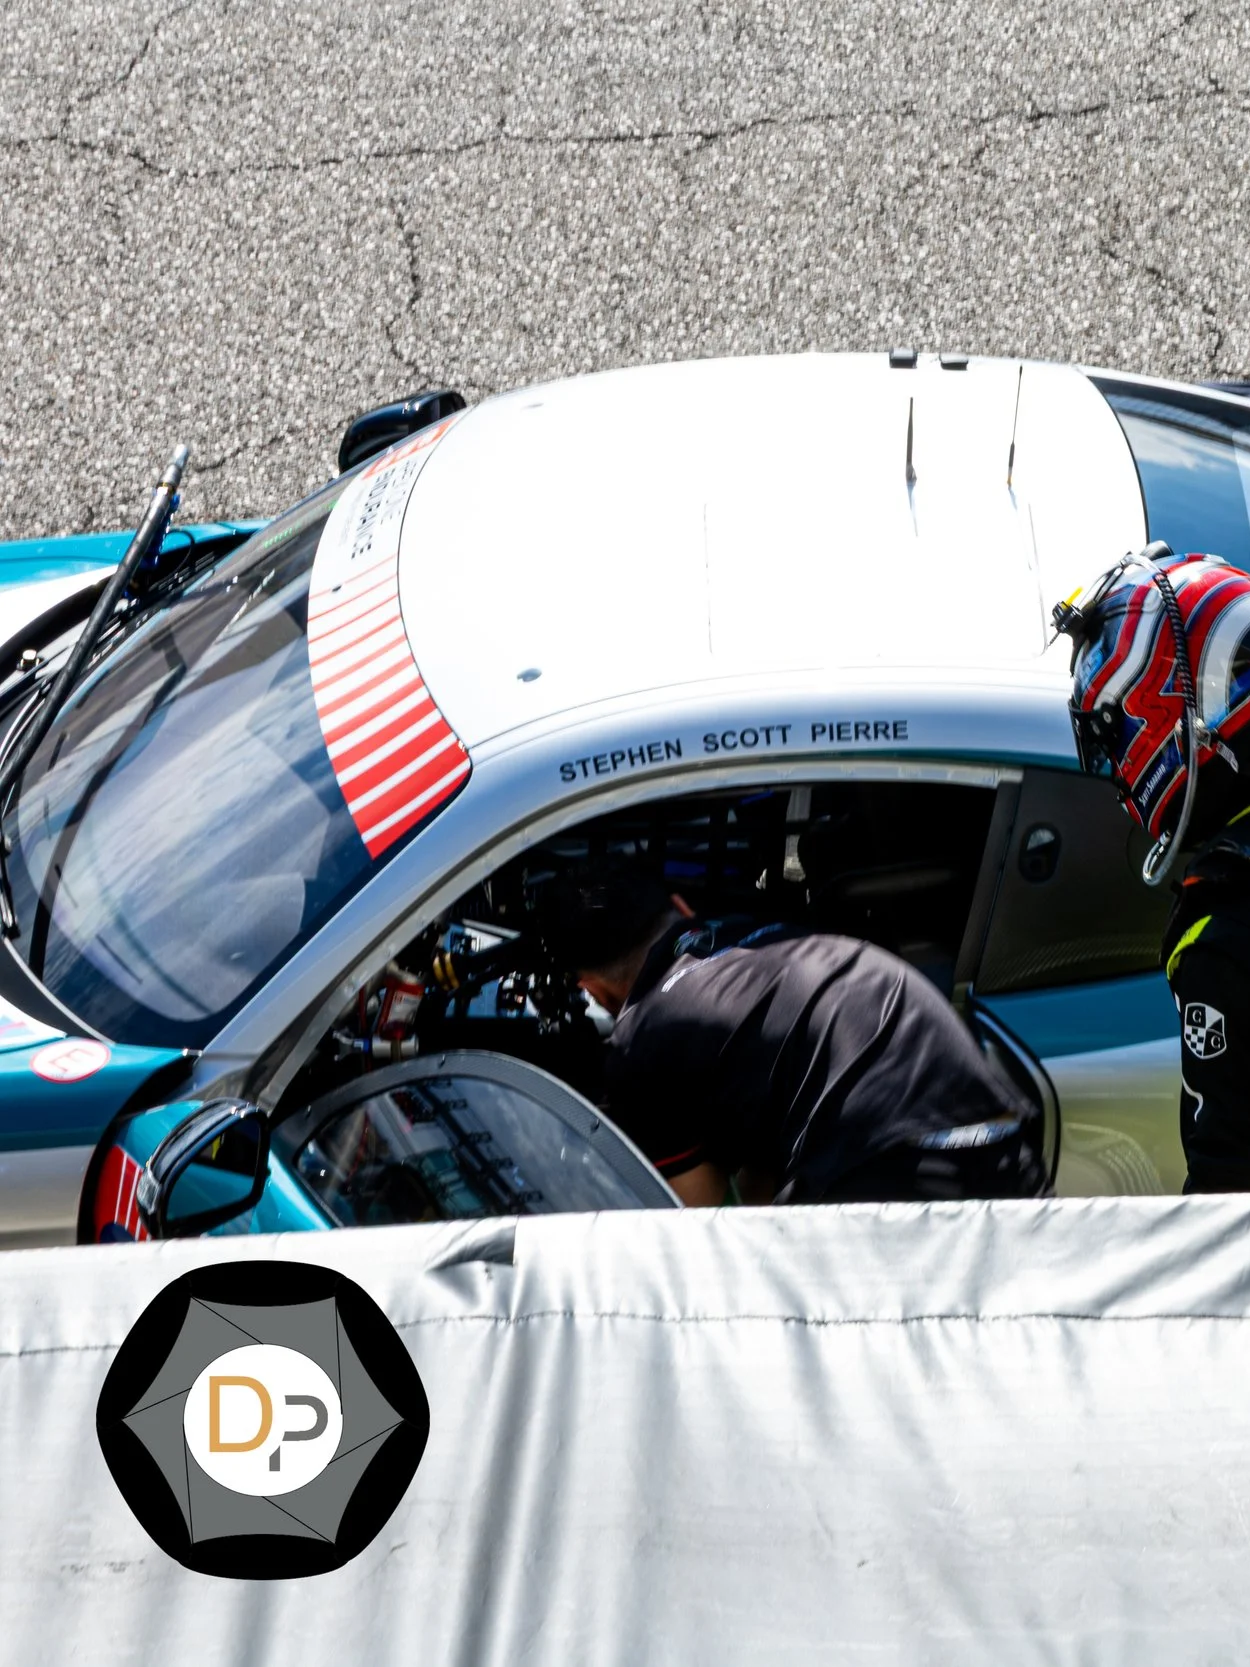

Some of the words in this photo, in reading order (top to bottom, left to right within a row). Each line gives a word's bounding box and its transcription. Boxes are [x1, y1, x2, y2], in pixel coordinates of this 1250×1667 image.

[559, 738, 683, 783] STEPHEN
[703, 724, 792, 753] SCOTT
[810, 720, 909, 743] PIERRE
